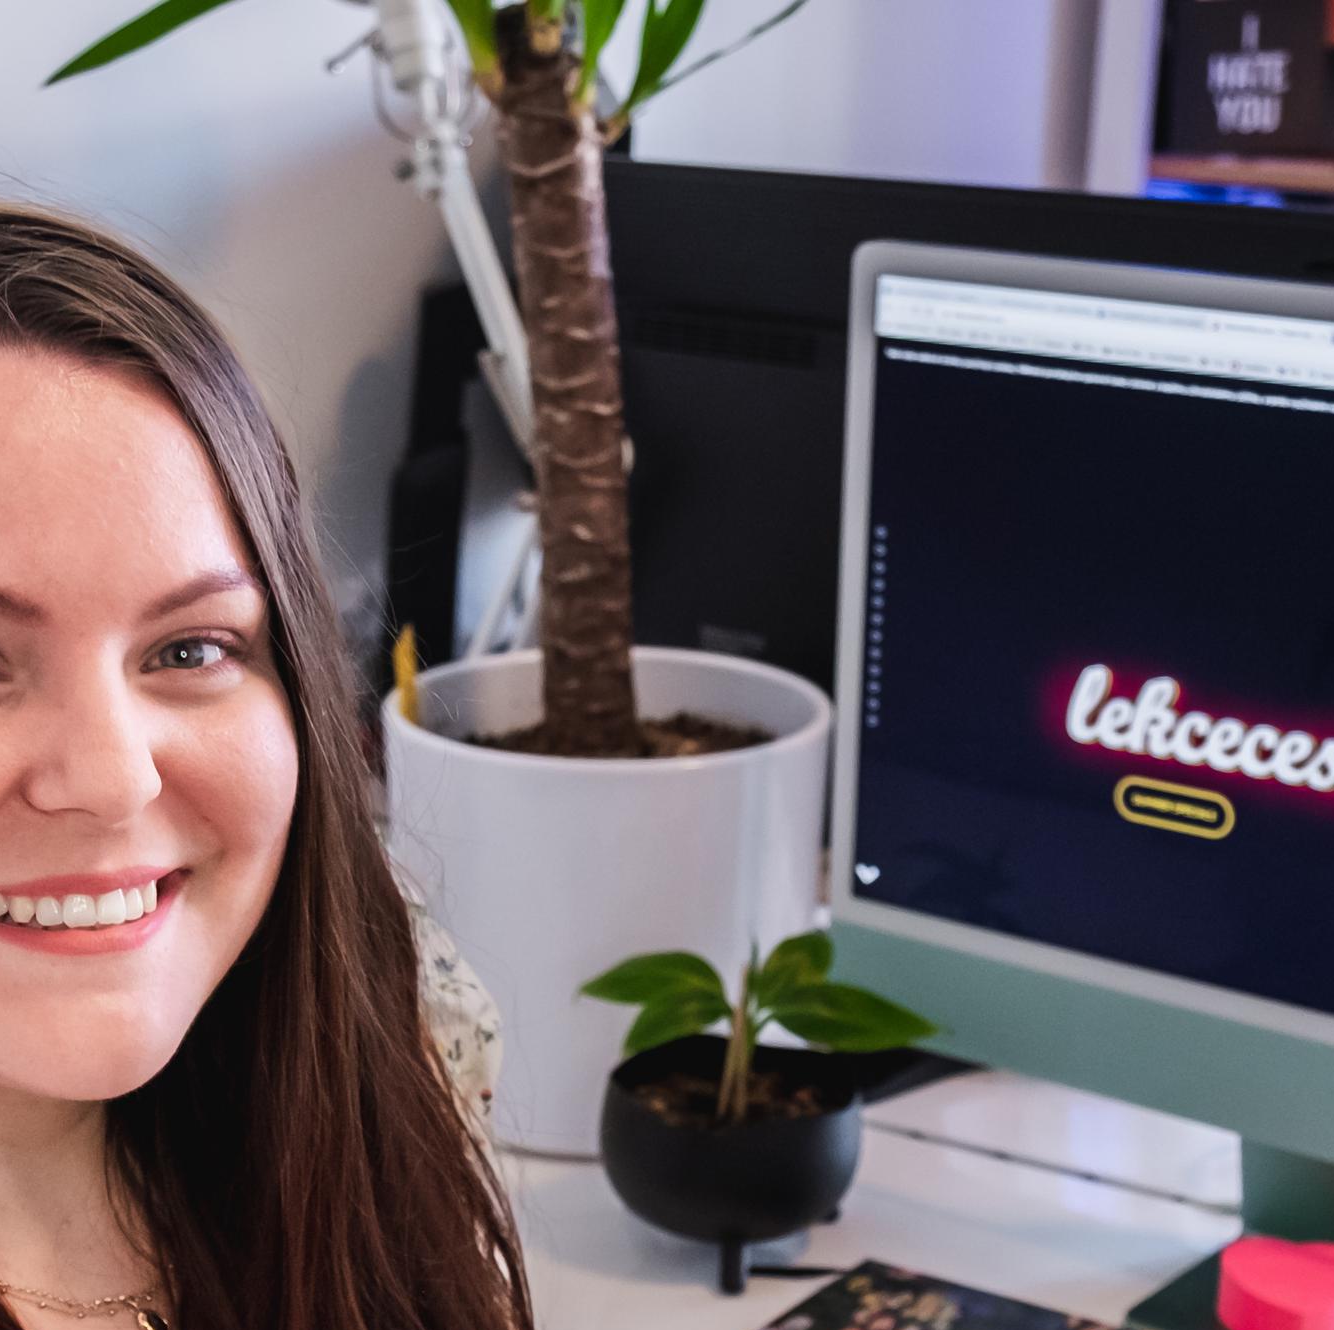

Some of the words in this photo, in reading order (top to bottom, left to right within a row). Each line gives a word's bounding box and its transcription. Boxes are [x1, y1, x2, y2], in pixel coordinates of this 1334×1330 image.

[1240, 12, 1260, 50] I
[1207, 52, 1290, 92] HATE
[1214, 94, 1282, 134] YOU
